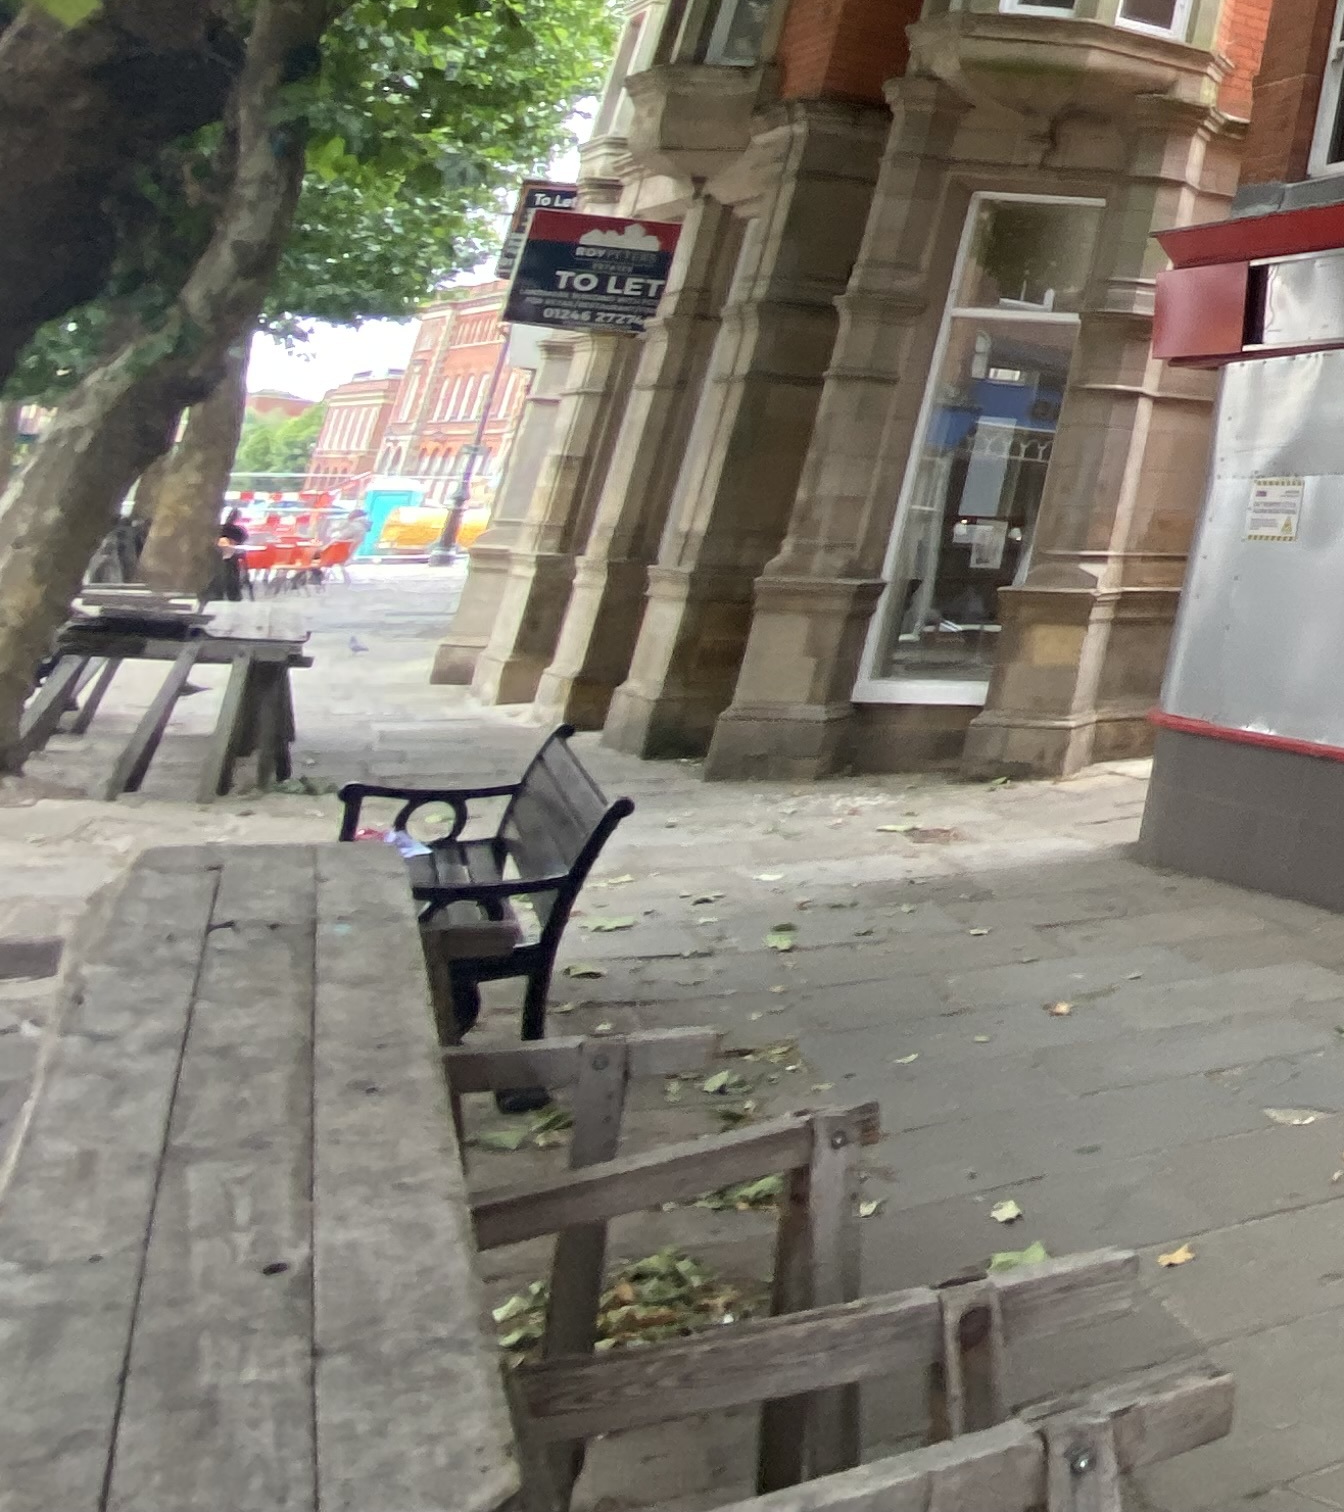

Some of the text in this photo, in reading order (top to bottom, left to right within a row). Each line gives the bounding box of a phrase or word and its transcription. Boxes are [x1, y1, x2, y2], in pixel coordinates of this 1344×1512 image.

[534, 193, 550, 207] To
[575, 246, 606, 257] ROY
[555, 270, 599, 291] TO
[606, 276, 666, 297] LET
[543, 307, 591, 321] 01246
